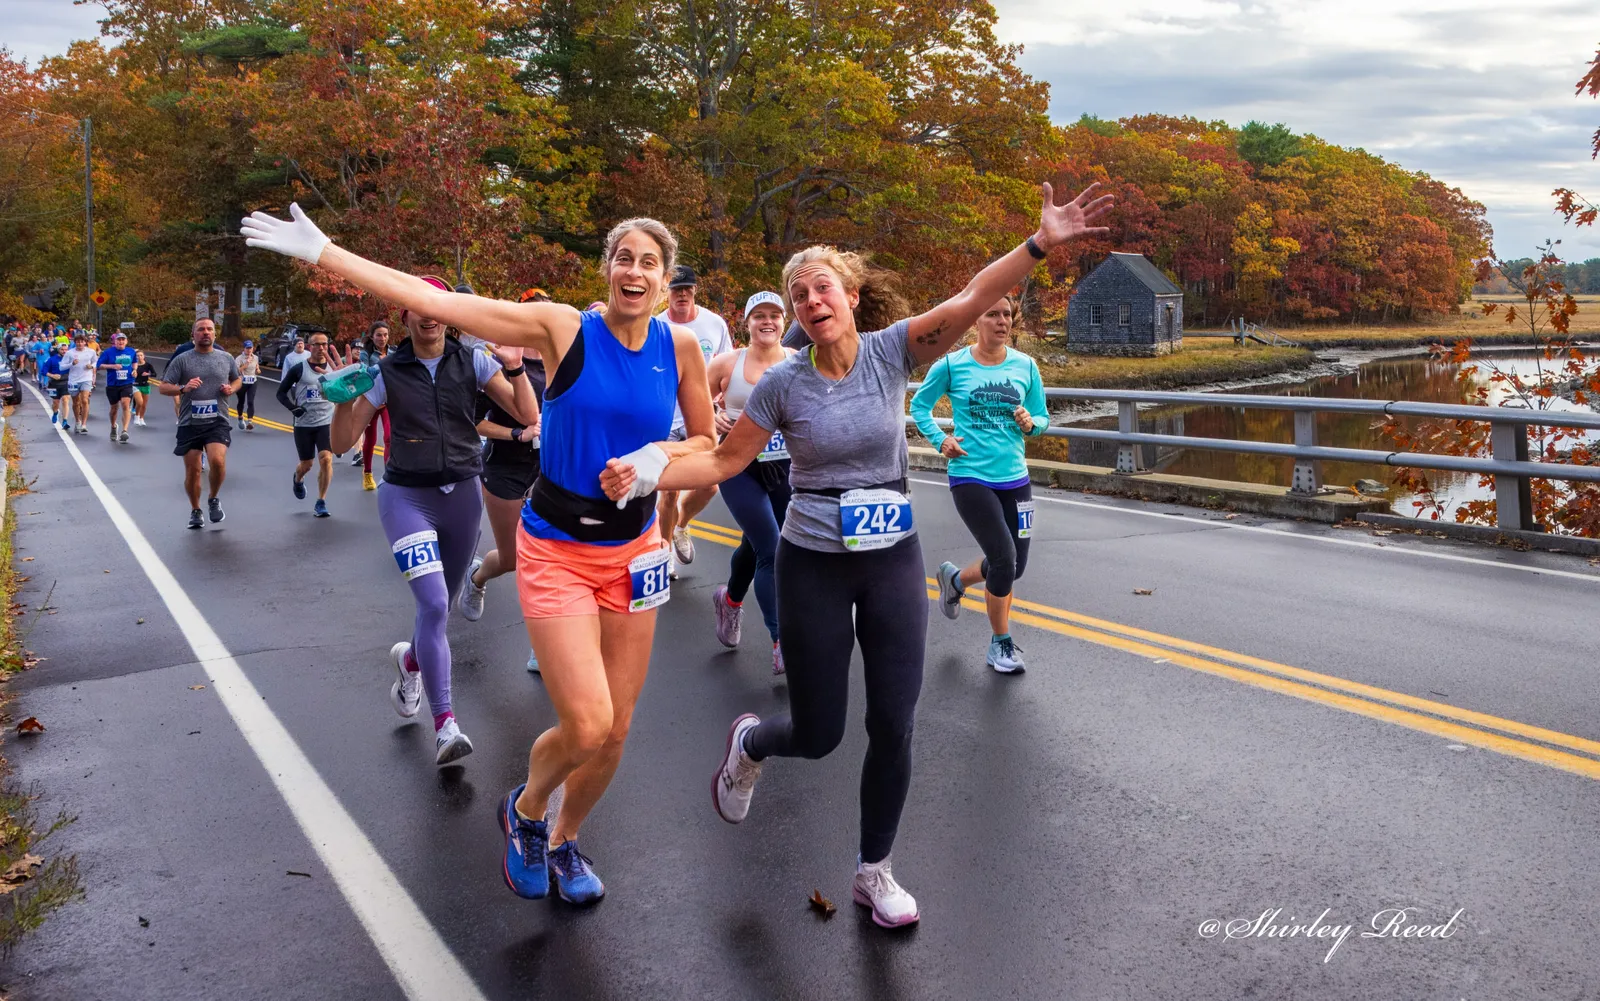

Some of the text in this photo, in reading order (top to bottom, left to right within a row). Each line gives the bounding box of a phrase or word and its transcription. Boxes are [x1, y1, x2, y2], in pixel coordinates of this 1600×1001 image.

[750, 292, 780, 305] TUFTS
[196, 405, 213, 414] 774
[854, 505, 901, 534] 242
[402, 542, 436, 568] 751
